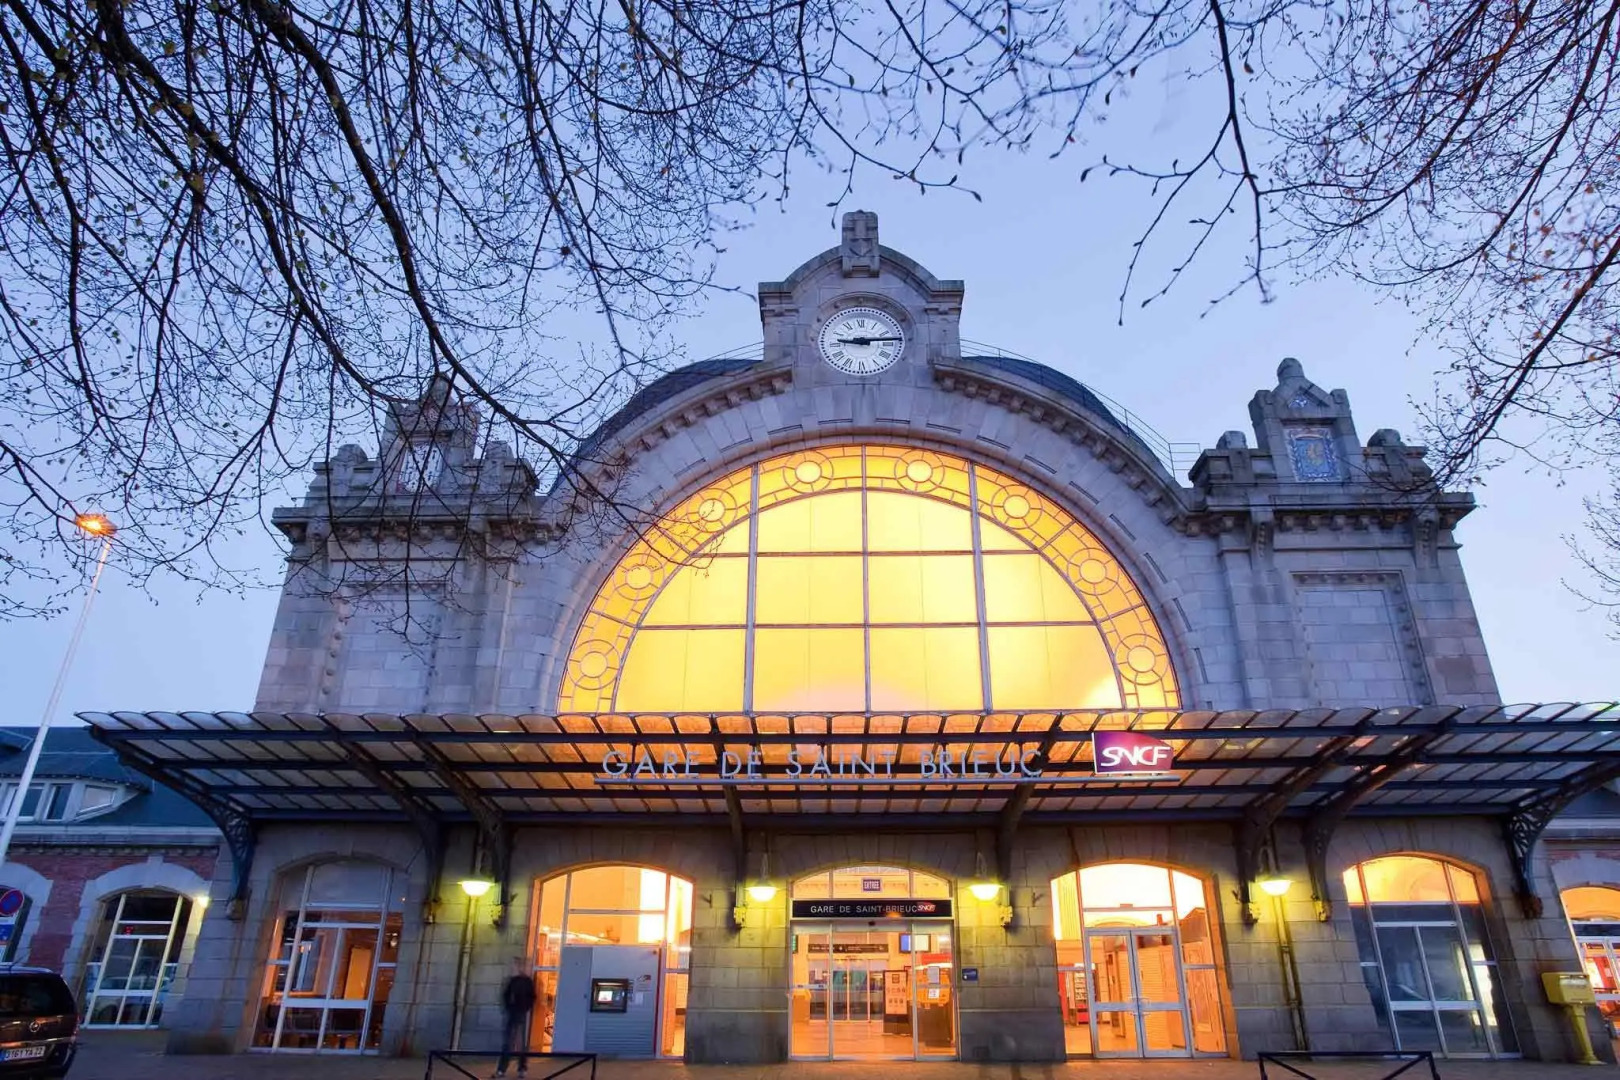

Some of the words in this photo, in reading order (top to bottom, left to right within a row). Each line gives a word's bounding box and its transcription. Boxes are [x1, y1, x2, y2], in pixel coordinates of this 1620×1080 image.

[602, 750, 700, 776] GARE
[721, 751, 762, 776] DE
[785, 750, 897, 776] SAINT
[920, 750, 1042, 776] BRIEUC
[1100, 745, 1171, 767] SNCF
[810, 905, 834, 913] GARE
[839, 905, 851, 913] DE
[856, 905, 917, 913] SAINT-BRIEUC
